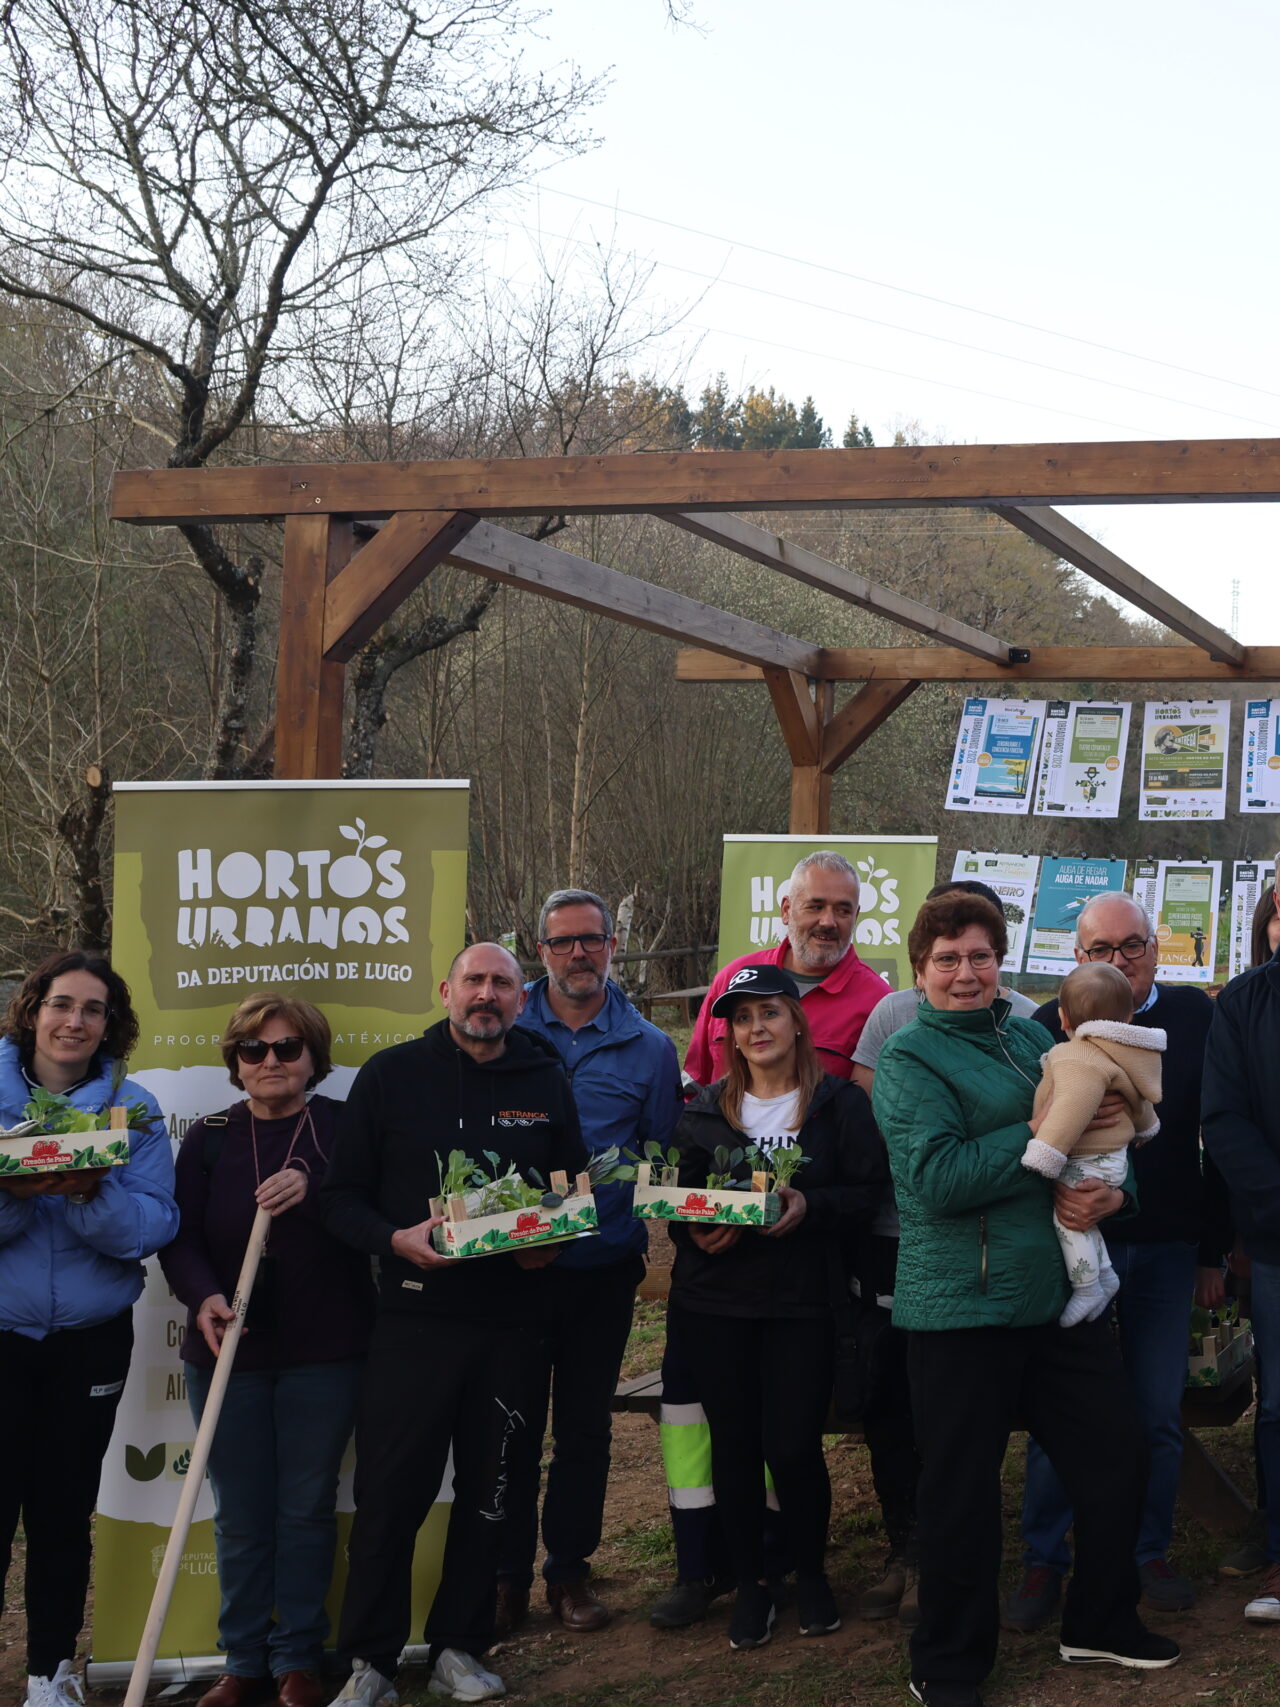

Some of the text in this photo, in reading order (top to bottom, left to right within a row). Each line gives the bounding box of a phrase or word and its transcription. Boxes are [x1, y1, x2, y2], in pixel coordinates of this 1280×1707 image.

[177, 848, 406, 900] HORTOS
[1060, 865, 1108, 876] AUGA DE REGAR
[1054, 874, 1108, 886] AUGA DE NADAR
[177, 906, 410, 950] URBANOS
[177, 957, 413, 988] DA DEPUTACIÓN DE LUGO
[154, 1030, 416, 1045] PROGR ATÉXICO
[190, 1561, 218, 1575] LUG
